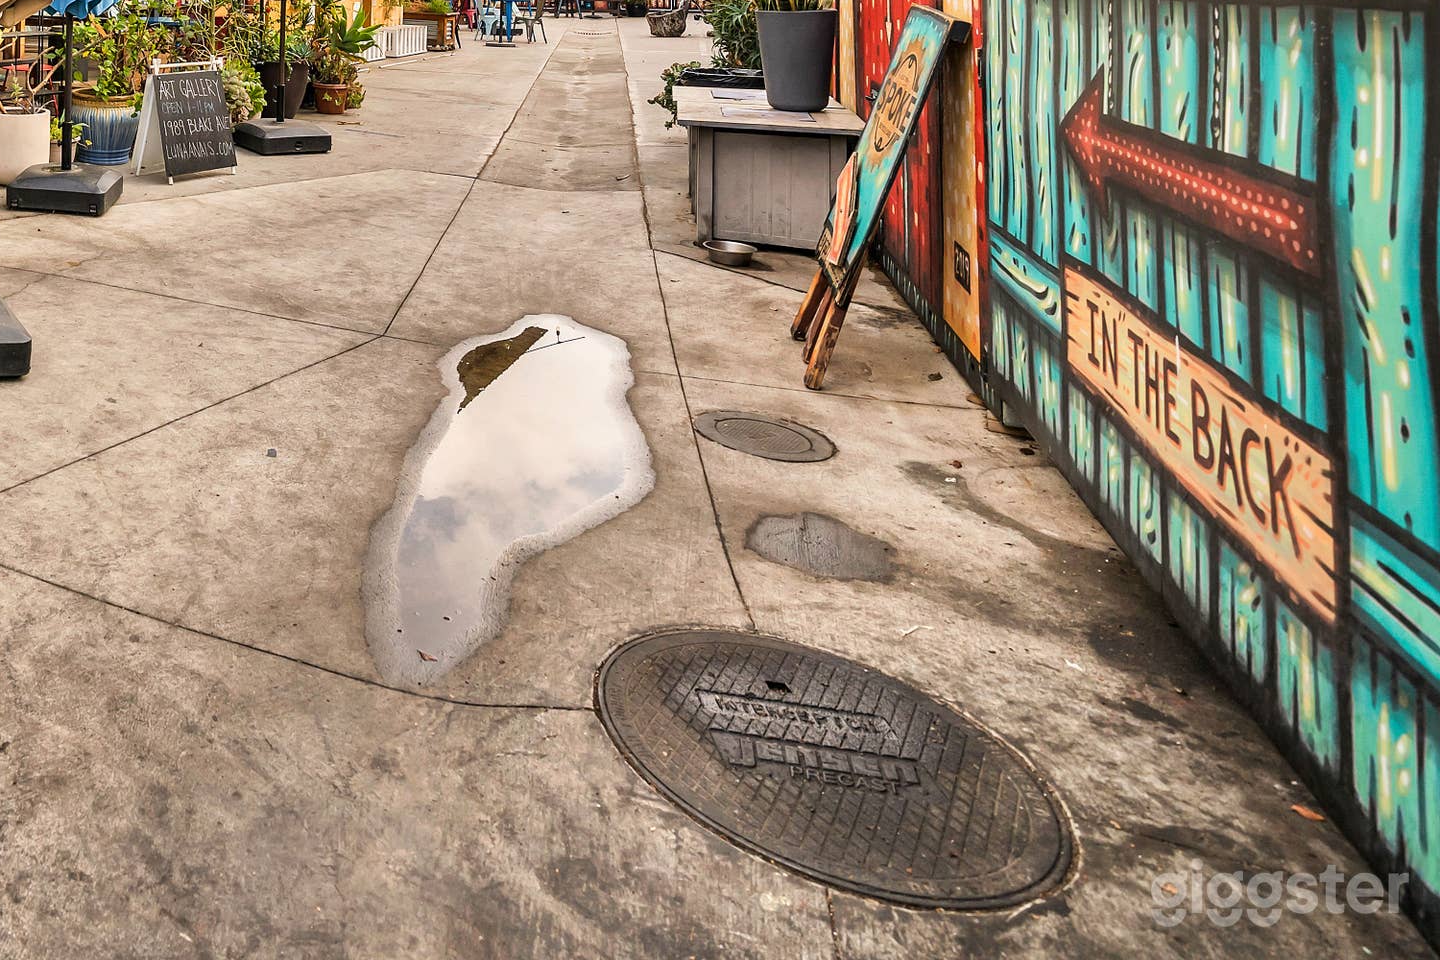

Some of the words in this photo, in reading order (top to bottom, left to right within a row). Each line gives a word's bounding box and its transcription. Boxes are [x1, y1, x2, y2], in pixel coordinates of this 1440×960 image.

[159, 80, 176, 100] ART
[179, 78, 222, 103] GALLERY
[161, 101, 184, 114] OPEN
[876, 78, 918, 134] SPOKE
[162, 119, 187, 137] 1989
[187, 117, 214, 136] BLAKE
[215, 115, 230, 132] AVE
[1085, 298, 1119, 386] IN
[1127, 327, 1182, 446] THE
[1190, 378, 1302, 560] BACK
[790, 765, 899, 794] PRECAST
